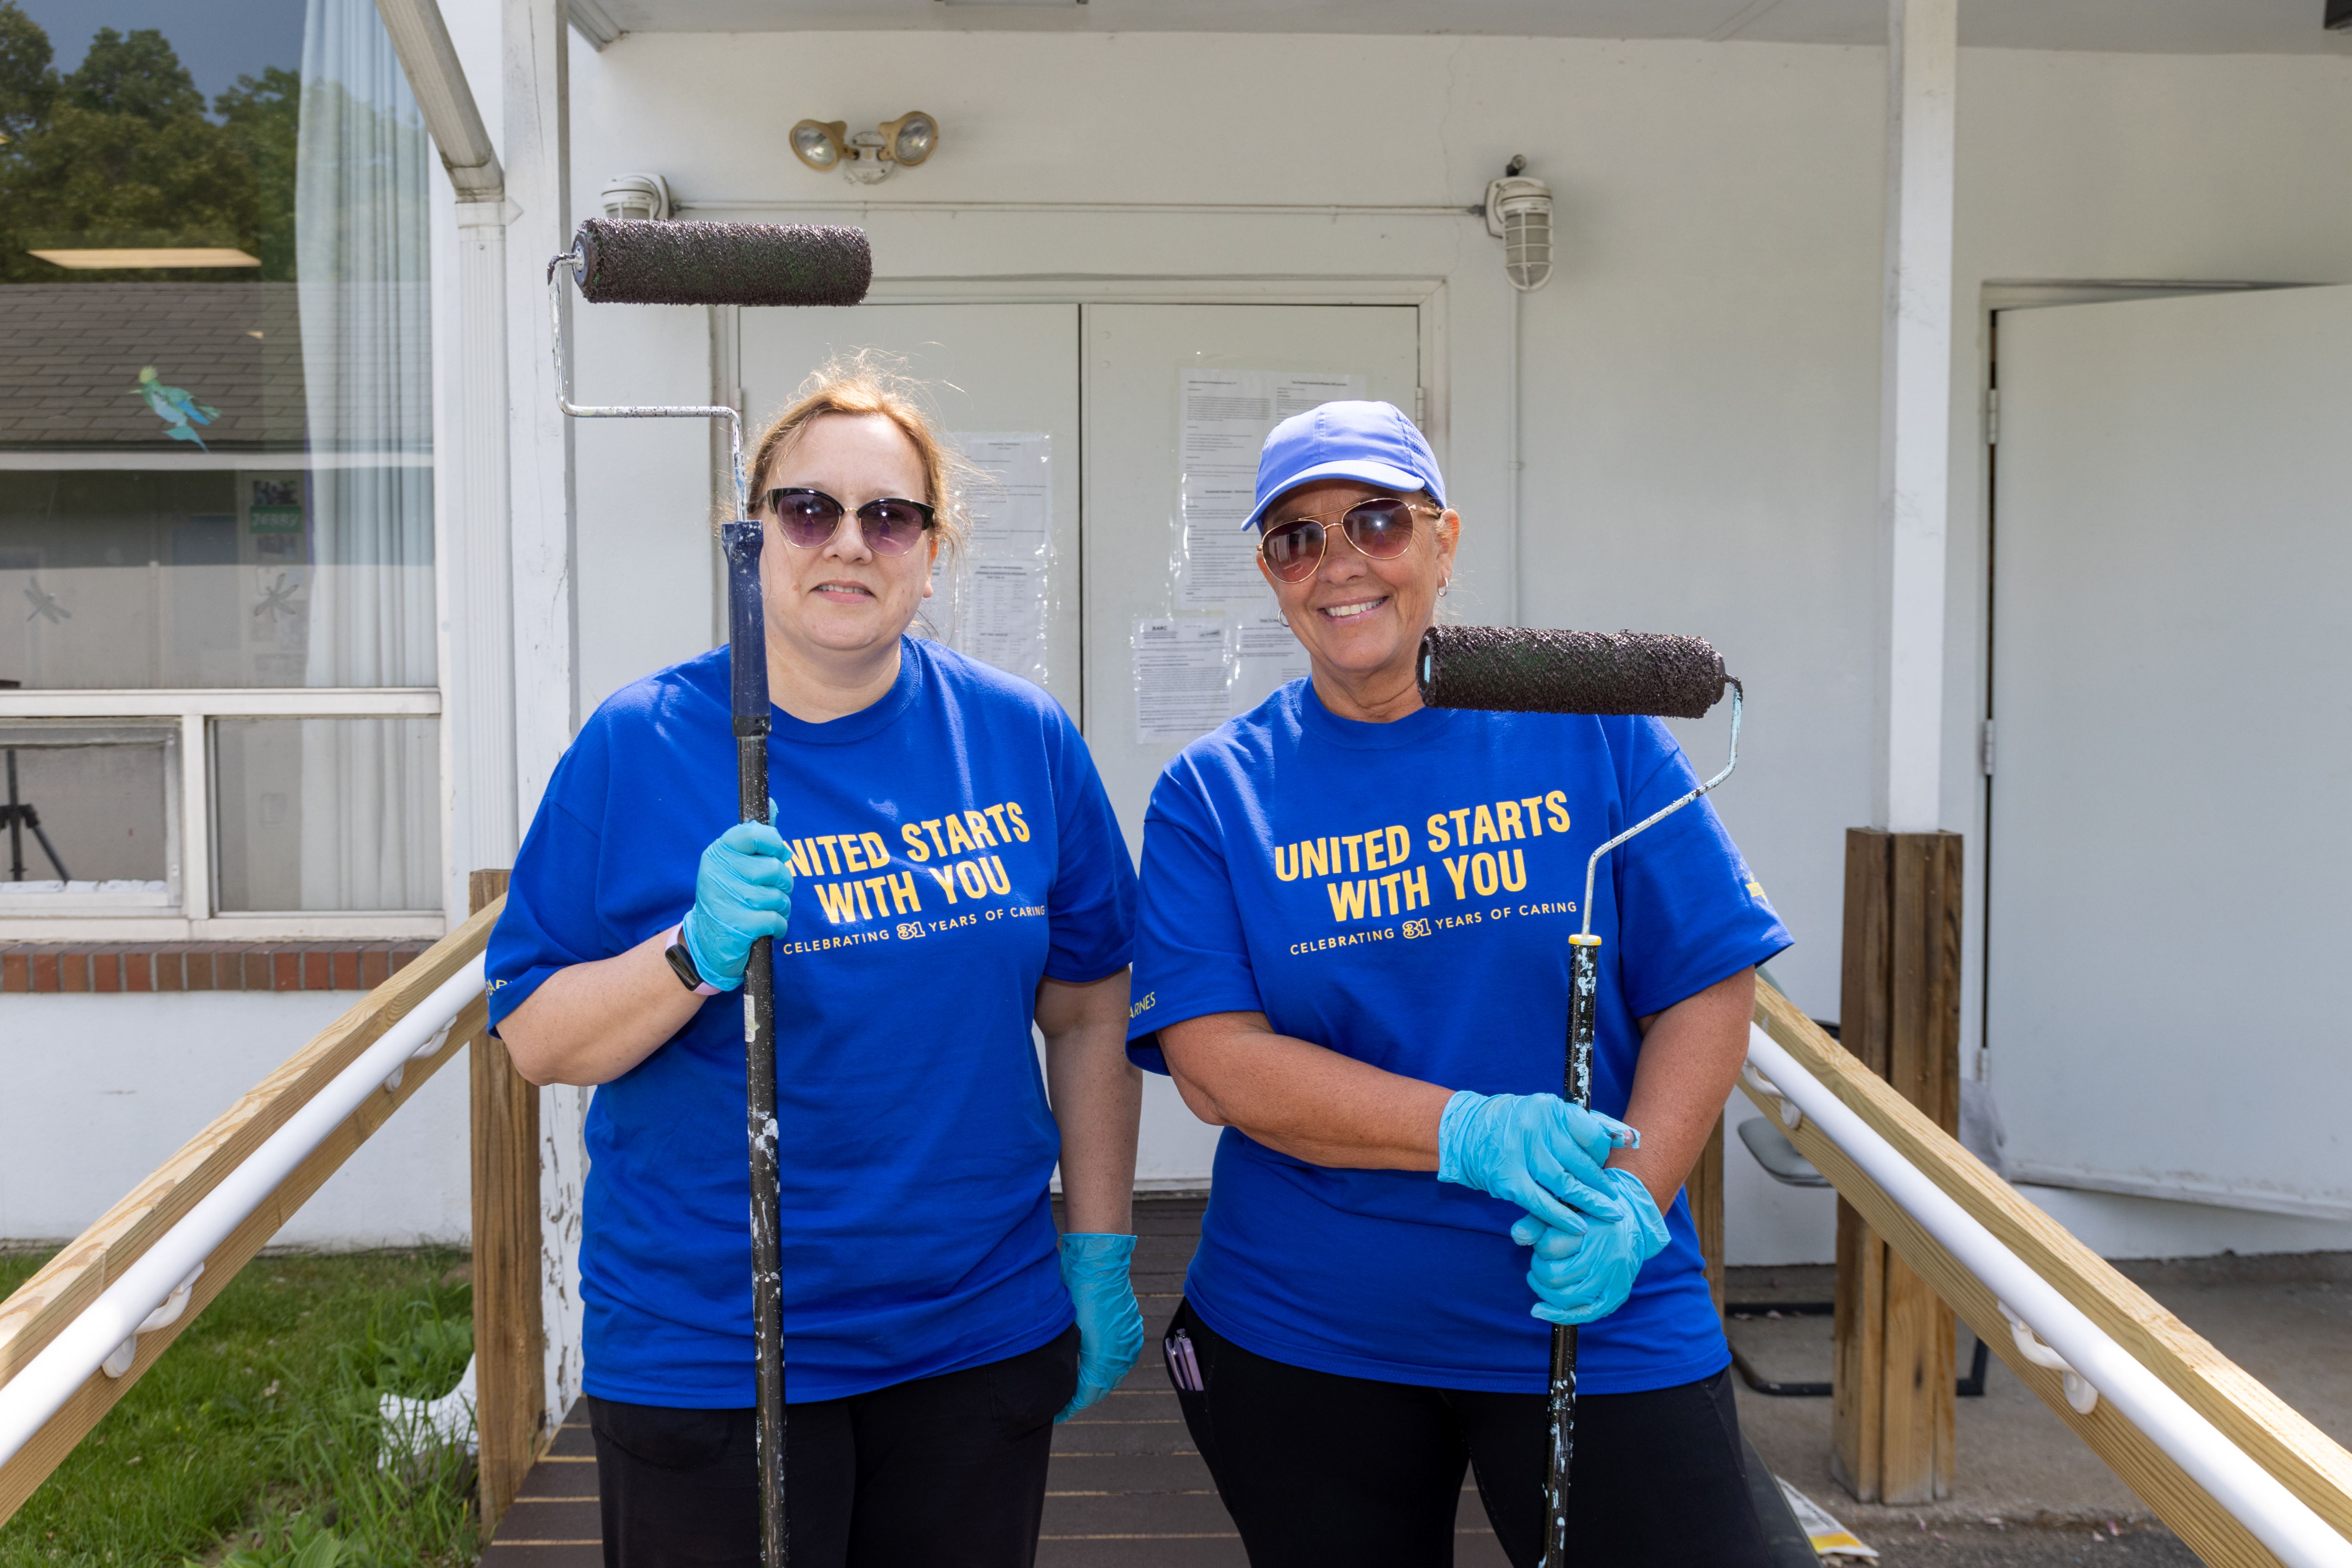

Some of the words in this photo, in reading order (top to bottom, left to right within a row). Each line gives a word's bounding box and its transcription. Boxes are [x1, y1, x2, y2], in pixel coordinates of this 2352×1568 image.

[783, 832, 890, 877] NITED
[901, 802, 1030, 862] STARTS
[1275, 825, 1410, 882] UNITED
[1427, 790, 1570, 852] STARTS
[814, 871, 921, 923] WITH
[928, 855, 1010, 904] YOU
[1327, 865, 1430, 922] WITH
[1443, 849, 1527, 900] YOU
[783, 929, 889, 955] CELEBRATING
[929, 914, 976, 933] YEARS
[985, 909, 1003, 920] OF
[1010, 905, 1045, 918] CARING
[1290, 928, 1394, 955] CELEBRATING
[1435, 912, 1482, 929] YEARS
[1490, 907, 1511, 920] OF
[1519, 901, 1576, 916] CARING
